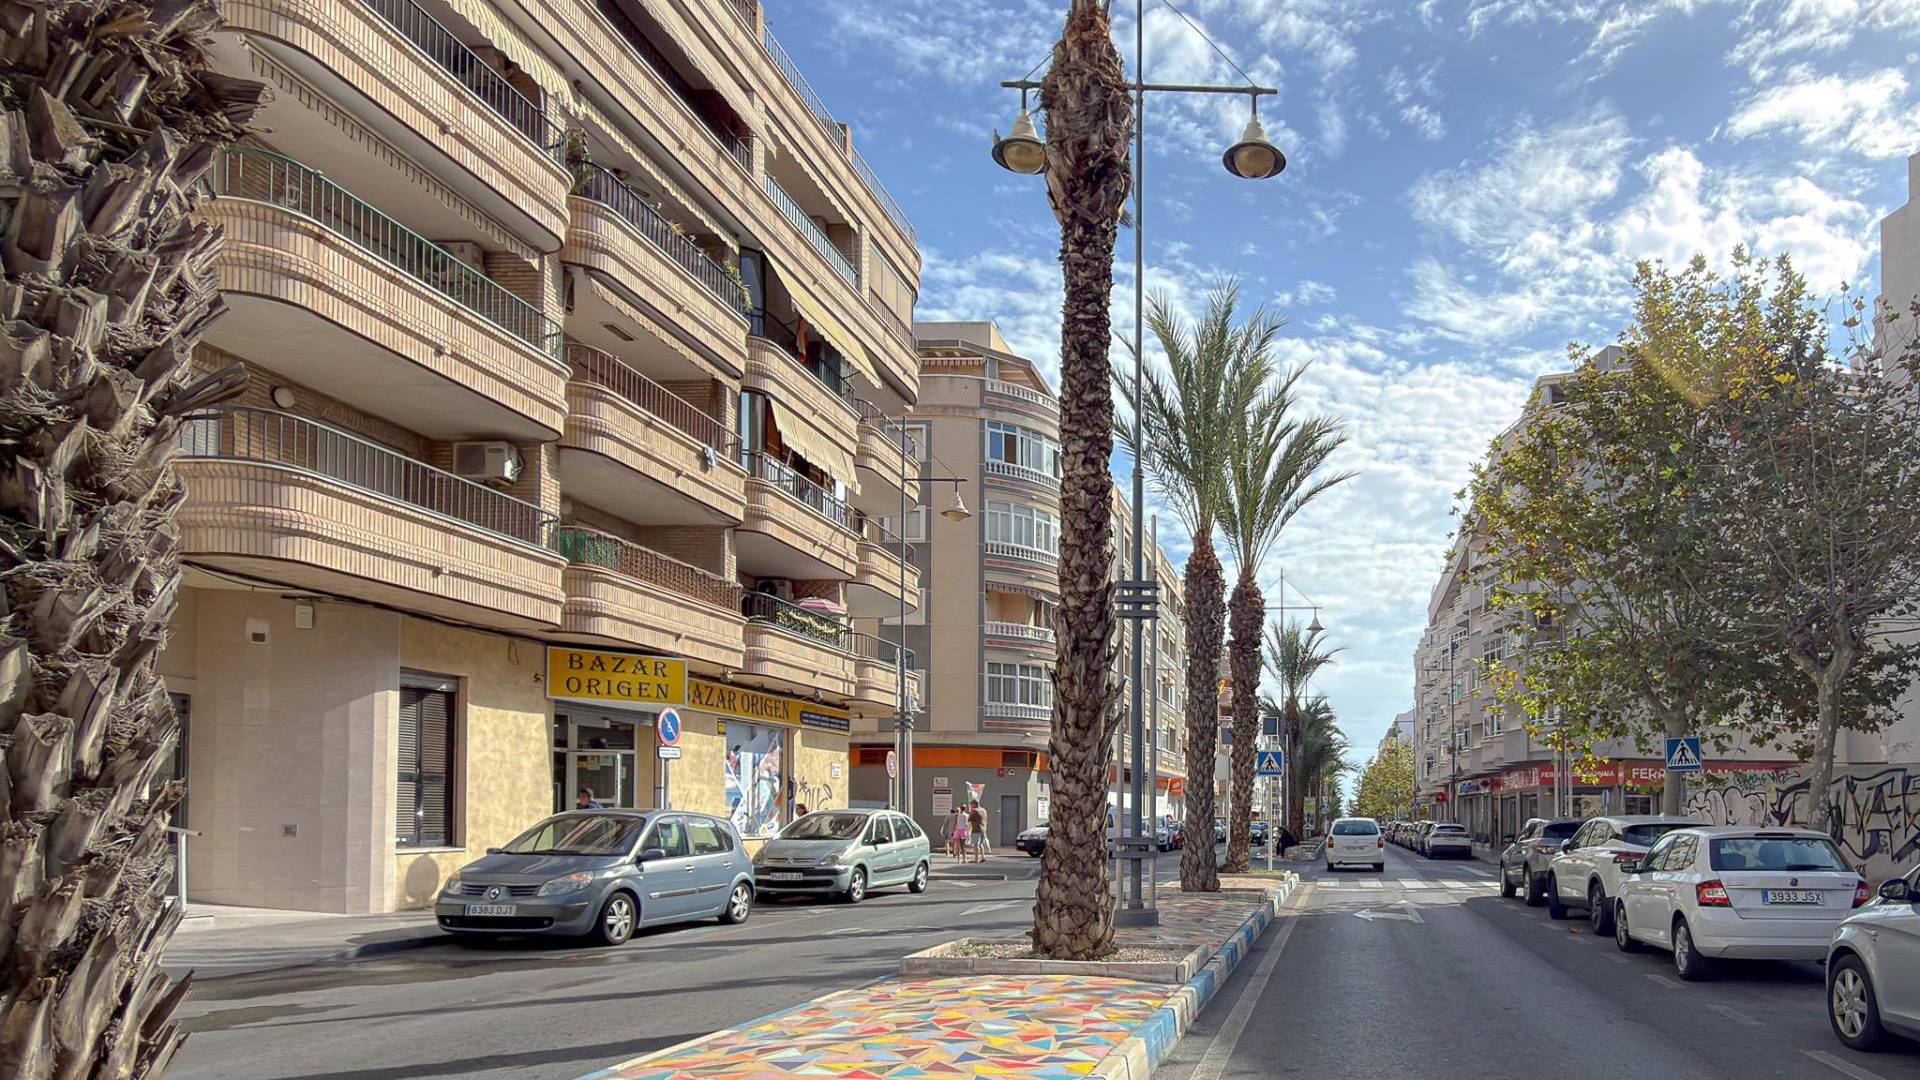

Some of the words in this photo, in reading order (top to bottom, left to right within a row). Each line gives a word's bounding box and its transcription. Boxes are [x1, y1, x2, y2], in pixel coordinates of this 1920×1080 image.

[568, 653, 667, 678] BAZAR
[566, 676, 669, 699] ORIGEN
[688, 683, 737, 712] AZAR
[741, 693, 790, 721] ORIGEN
[1770, 890, 1798, 902] 3933
[1802, 890, 1823, 902] JSX
